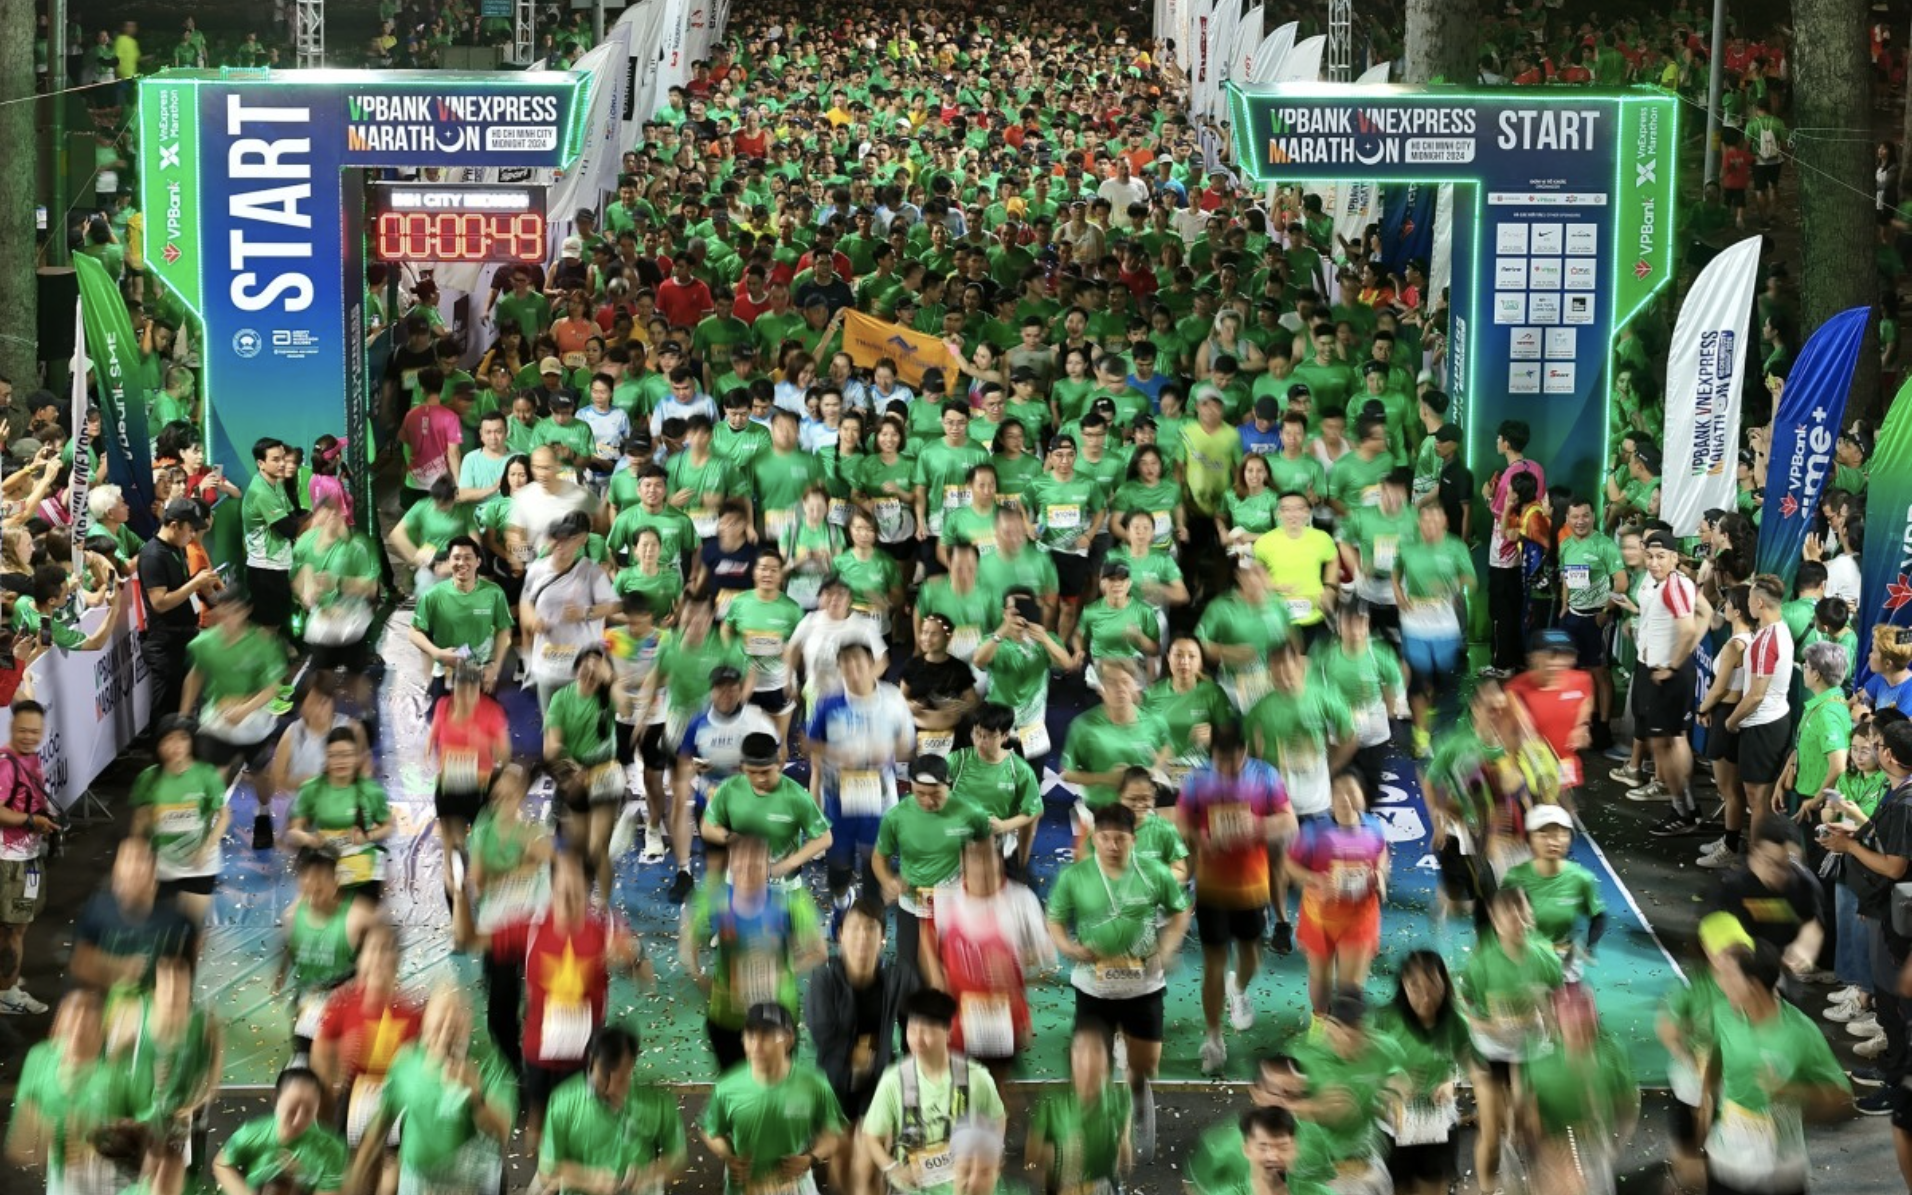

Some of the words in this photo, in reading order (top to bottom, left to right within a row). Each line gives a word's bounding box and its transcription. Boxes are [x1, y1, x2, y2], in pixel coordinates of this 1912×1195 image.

[159, 89, 168, 142] VnExpress
[169, 89, 179, 138] Marathon
[348, 95, 432, 122] VPBANK
[436, 95, 557, 122] VNEXPRESS
[1270, 108, 1352, 134] VPBANK
[1357, 108, 1476, 134] VNEXPRESS
[1498, 109, 1600, 151] START
[1647, 106, 1658, 155] Marathon
[348, 124, 481, 153] MARATHON
[491, 139, 526, 148] MIDNIGHT
[527, 139, 547, 148] 2024
[503, 129, 515, 138] CHI
[516, 129, 536, 138] MINH
[537, 129, 554, 138] CITY
[1269, 137, 1400, 165] MARATHON
[1411, 151, 1446, 161] MIDNIGHT
[1446, 151, 1465, 161] 2024
[1423, 141, 1434, 149] CHI
[1435, 141, 1454, 149] MINH
[1455, 141, 1472, 149] CITY
[1637, 106, 1648, 159] VnExpress
[167, 180, 181, 240] VPBank
[227, 93, 315, 312] START
[1640, 196, 1655, 256] VPBank
[380, 213, 542, 260] 00:00:49
[106, 331, 122, 378] SME
[1695, 330, 1719, 416] VNEXPRESS
[1692, 419, 1712, 476] VPBANK
[1789, 423, 1808, 490] VPBank
